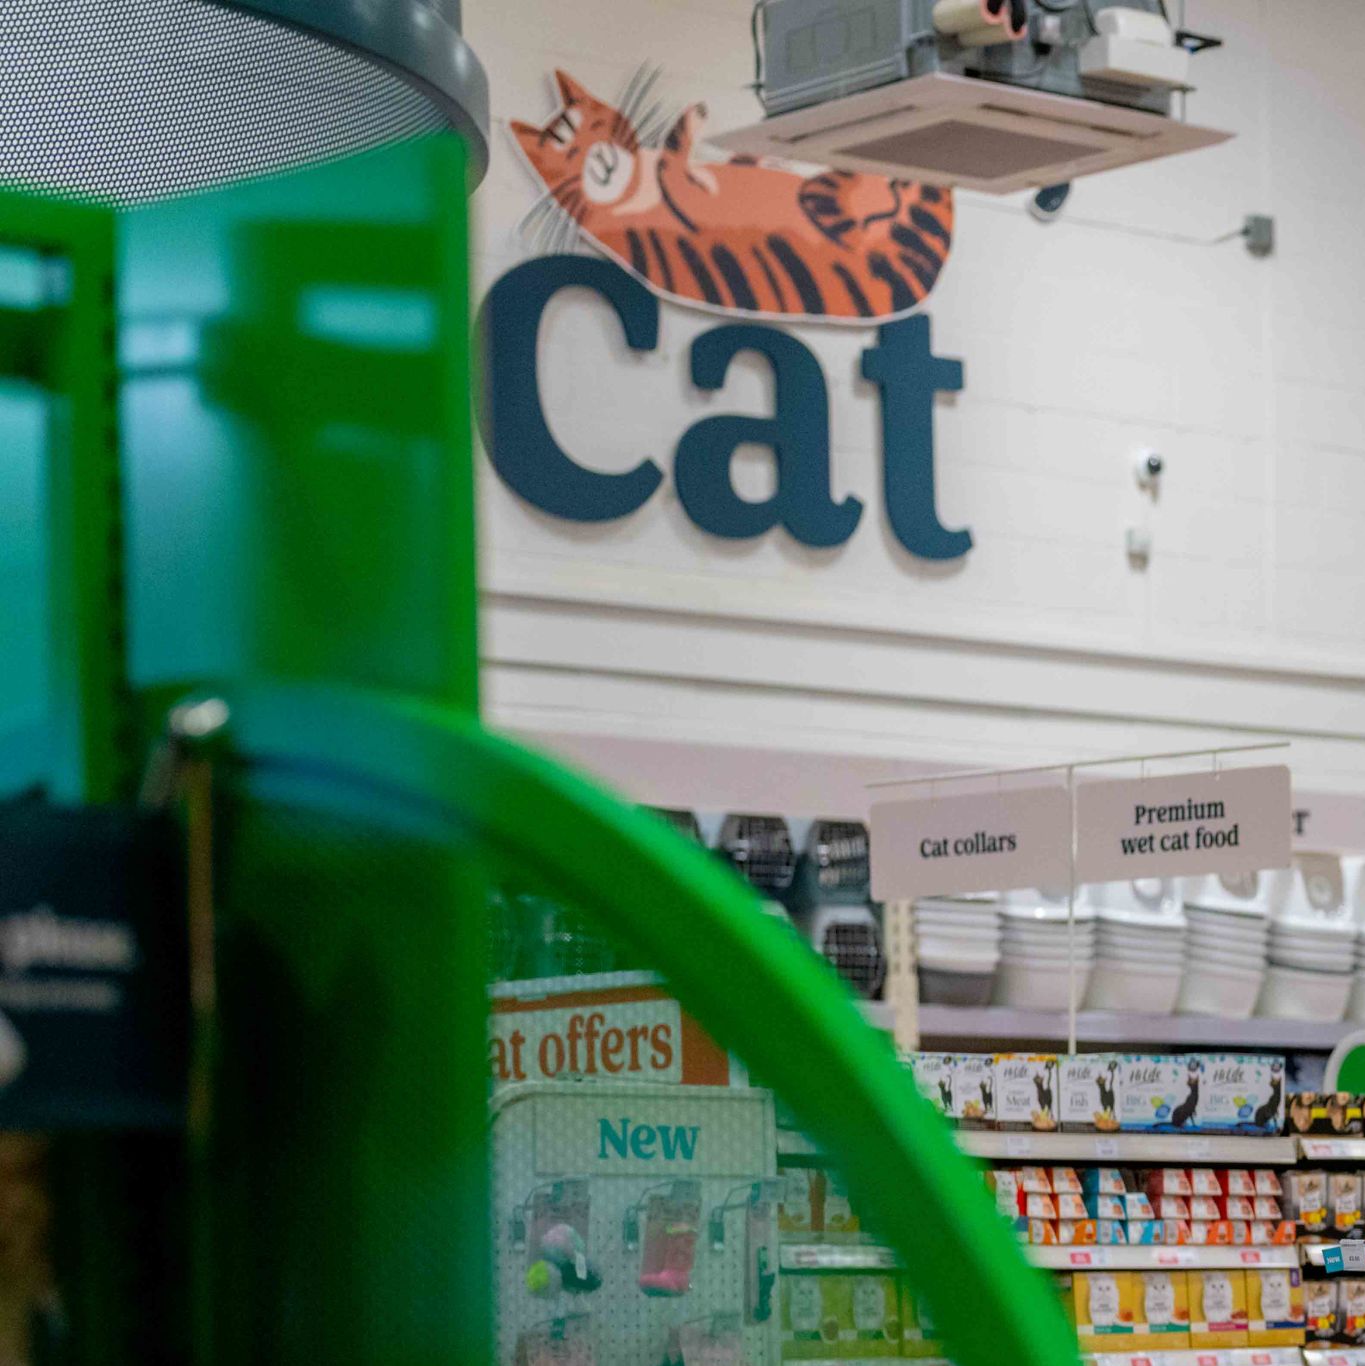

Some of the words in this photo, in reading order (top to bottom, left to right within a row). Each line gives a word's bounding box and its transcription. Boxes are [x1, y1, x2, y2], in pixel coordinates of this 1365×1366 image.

[475, 254, 974, 561] Cat
[1133, 797, 1225, 826] Premium
[919, 837, 951, 860] Cat
[953, 830, 1018, 857] collars
[1120, 832, 1155, 855] wet
[1160, 829, 1190, 853] cat
[1194, 824, 1240, 850] food
[538, 1012, 674, 1078] offers
[597, 1117, 702, 1161] New
[1326, 1253, 1342, 1264] New
